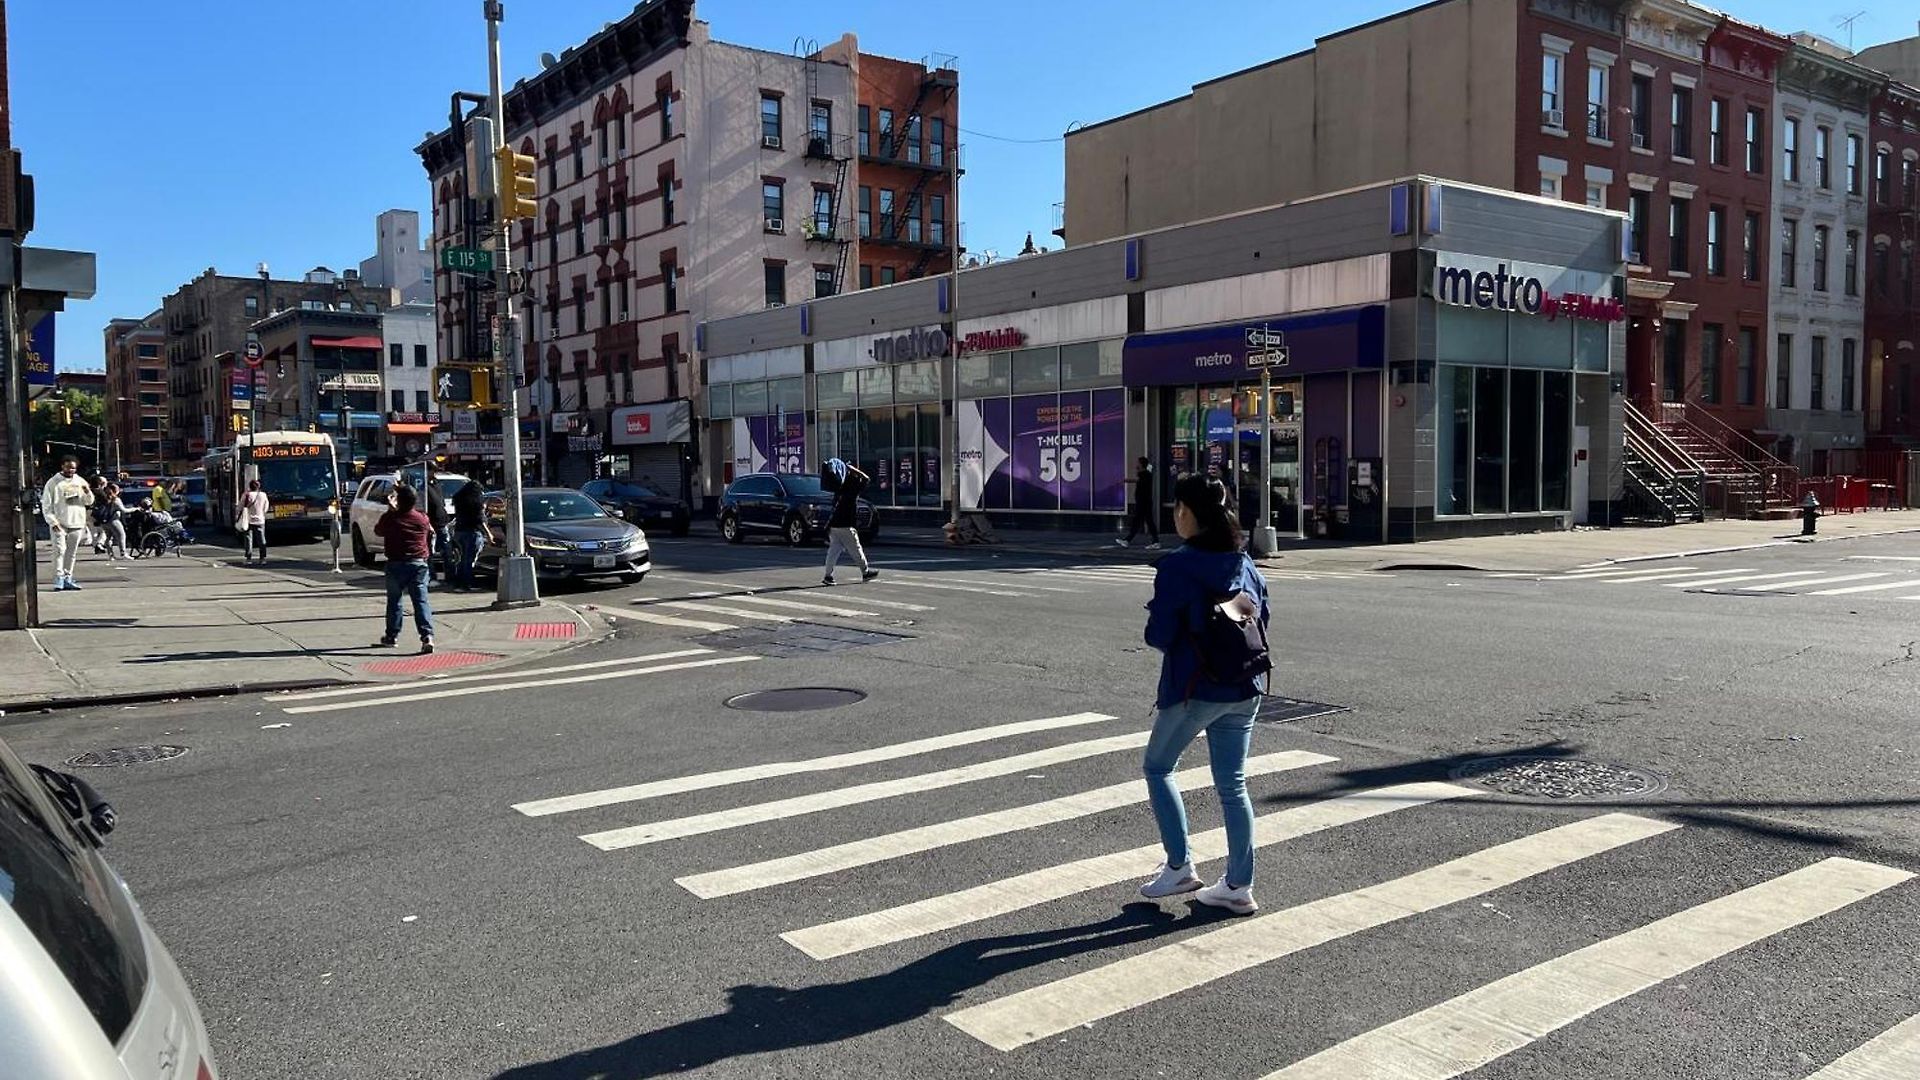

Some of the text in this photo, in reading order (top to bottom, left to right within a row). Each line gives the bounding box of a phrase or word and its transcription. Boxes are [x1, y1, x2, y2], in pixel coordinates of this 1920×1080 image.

[447, 250, 454, 266] E
[459, 251, 476, 268] 115
[1435, 263, 1543, 315] metro
[873, 326, 947, 362] metro
[964, 326, 1023, 352] T-Mobile
[1195, 352, 1233, 367] metro
[351, 374, 379, 385] TAXES
[1037, 434, 1083, 447] T-MOBILE
[291, 446, 306, 456] LEX
[960, 448, 983, 460] metro
[1039, 446, 1081, 482] 5G
